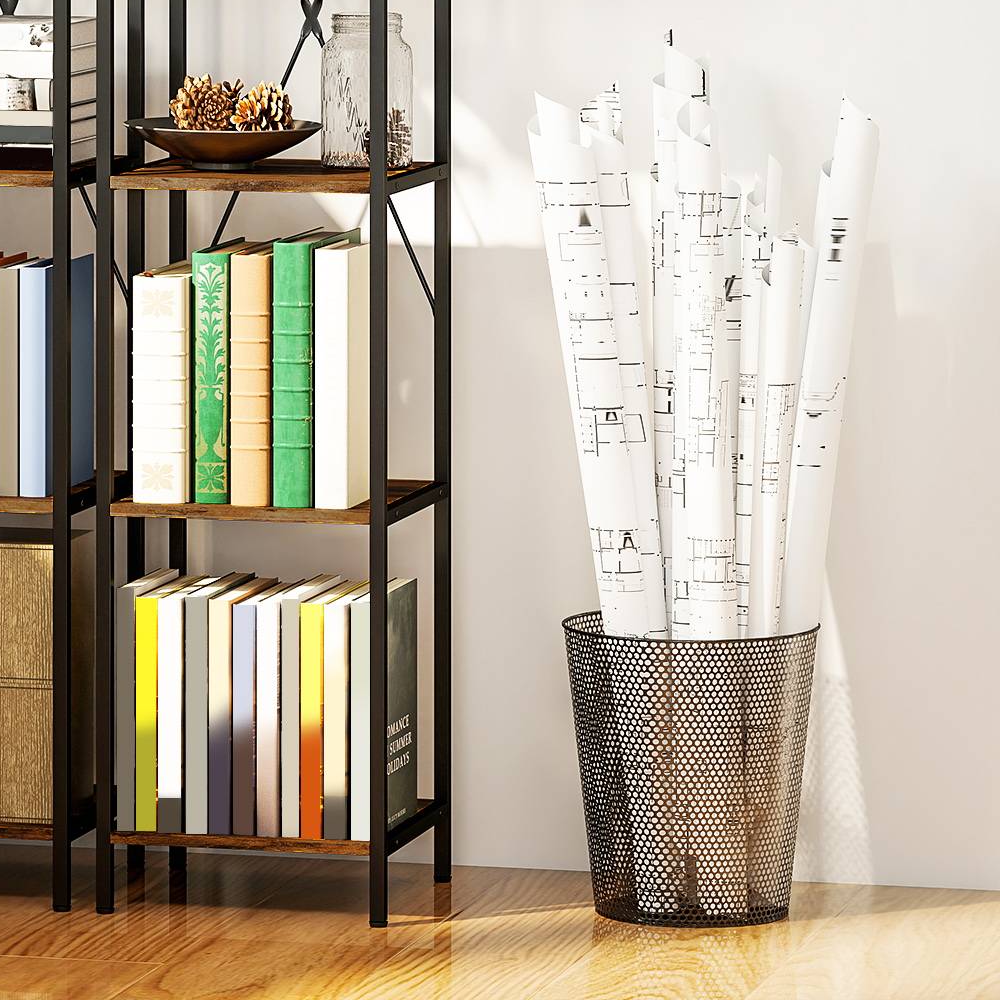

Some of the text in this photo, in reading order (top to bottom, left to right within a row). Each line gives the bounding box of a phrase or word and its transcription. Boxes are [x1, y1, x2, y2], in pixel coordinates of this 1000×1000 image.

[387, 714, 409, 738] OMANCE
[390, 732, 412, 755] SUMMER
[387, 751, 410, 775] OLIDAYS
